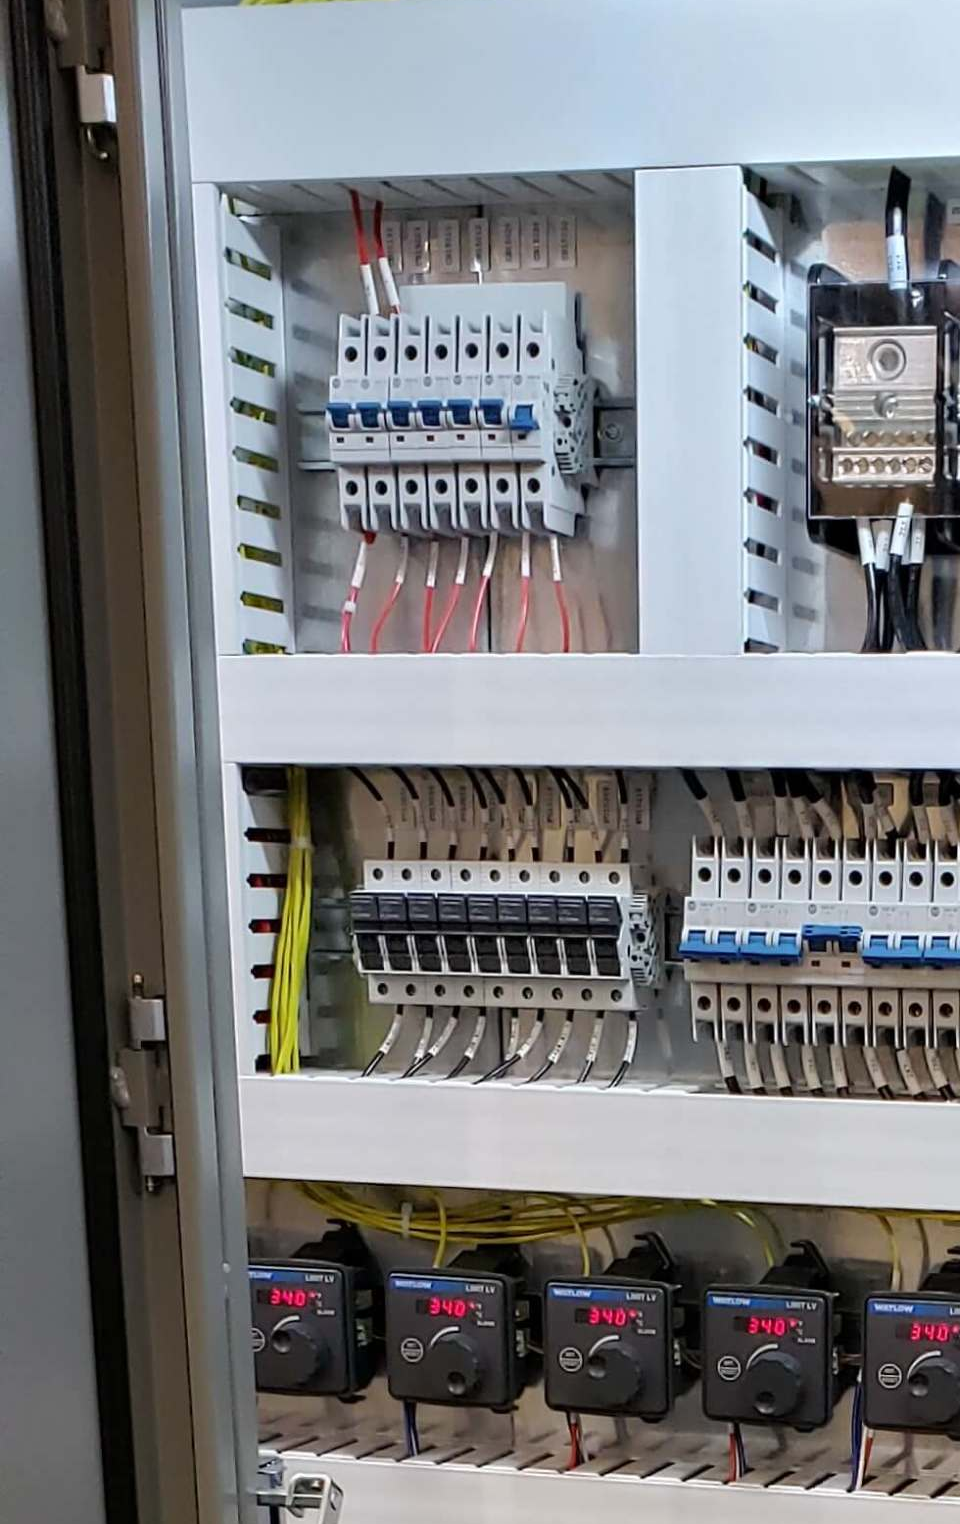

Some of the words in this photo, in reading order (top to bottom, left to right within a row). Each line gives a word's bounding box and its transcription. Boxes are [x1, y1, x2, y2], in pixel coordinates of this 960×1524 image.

[269, 1287, 306, 1308] 340
[429, 1298, 466, 1318] 340
[588, 1306, 627, 1327] 340
[874, 1303, 914, 1313] WATLOW
[747, 1316, 786, 1337] 340
[910, 1322, 949, 1342] 340
